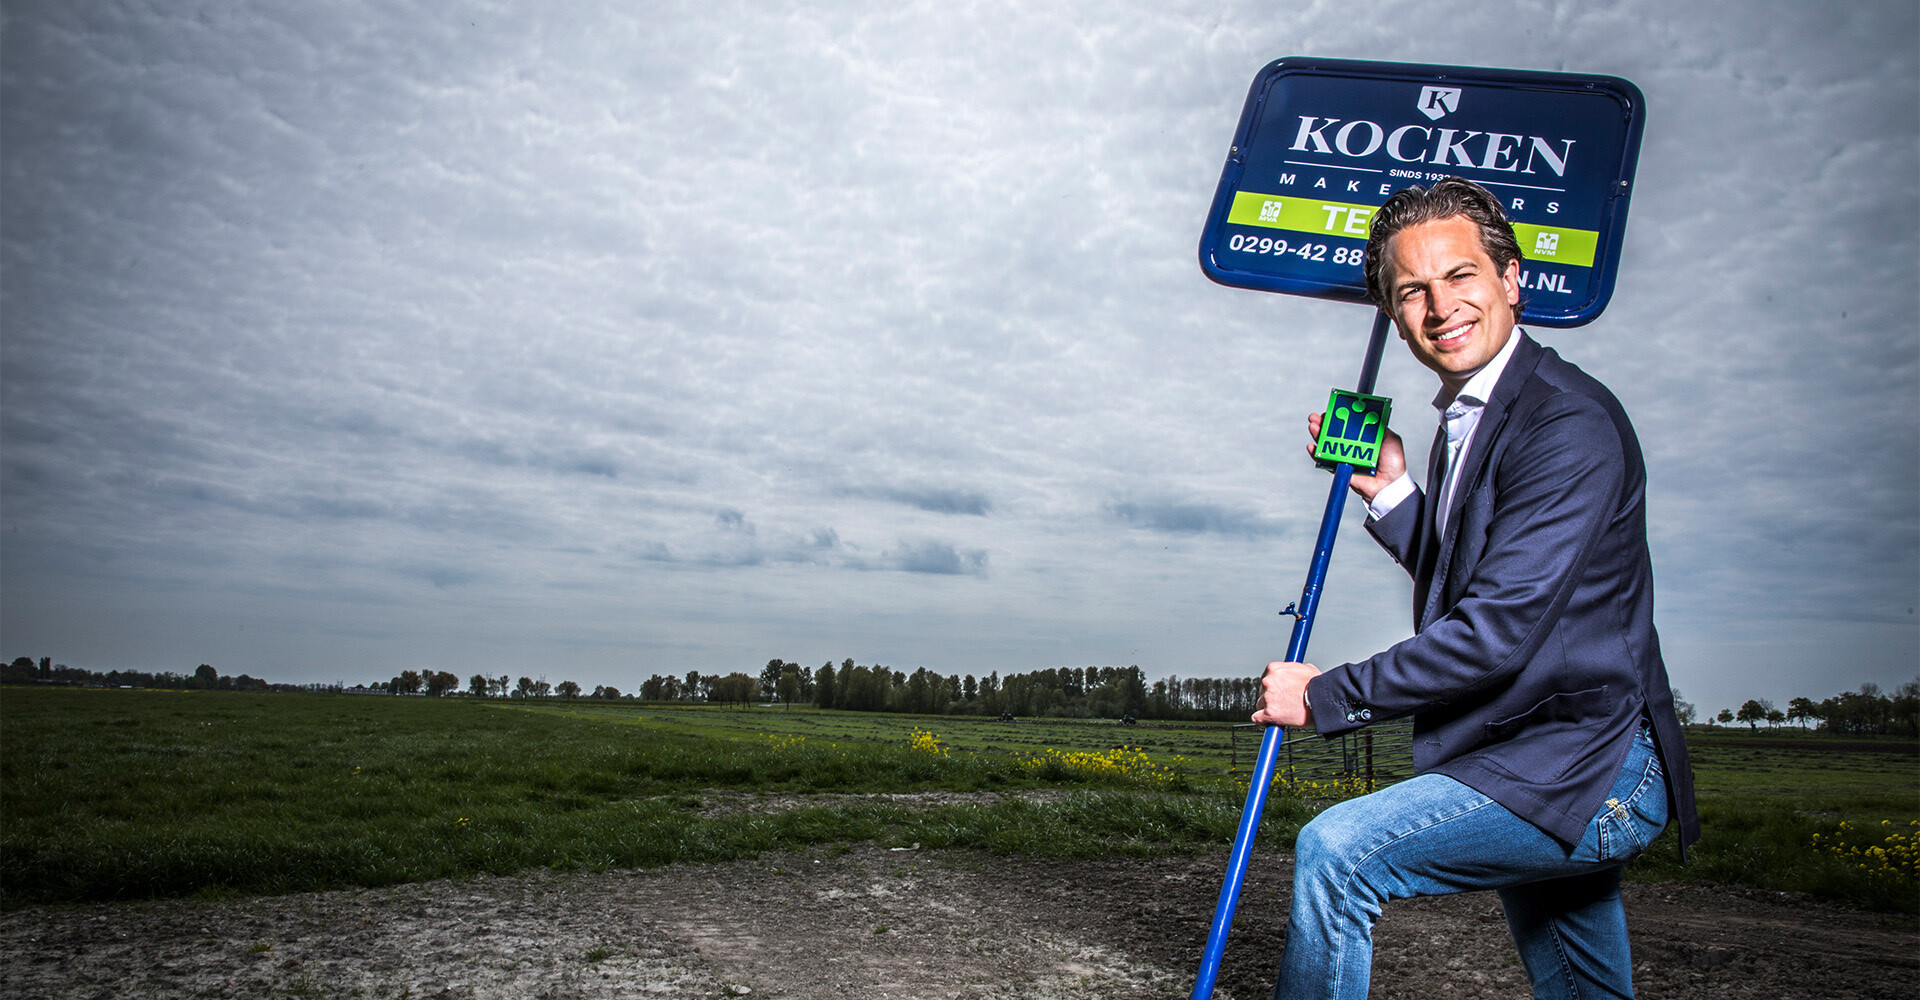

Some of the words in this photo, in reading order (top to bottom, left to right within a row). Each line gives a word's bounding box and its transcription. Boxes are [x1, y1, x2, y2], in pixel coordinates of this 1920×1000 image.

[1425, 90, 1454, 114] K
[1288, 115, 1577, 177] KOCKEN
[1389, 168, 1423, 180] SINDS
[1258, 215, 1278, 223] MVA
[1321, 204, 1372, 235] TE
[1229, 234, 1328, 262] 0299-42
[1332, 246, 1364, 267] 88
[1533, 248, 1557, 256] NVM
[1321, 440, 1375, 461] NVM
